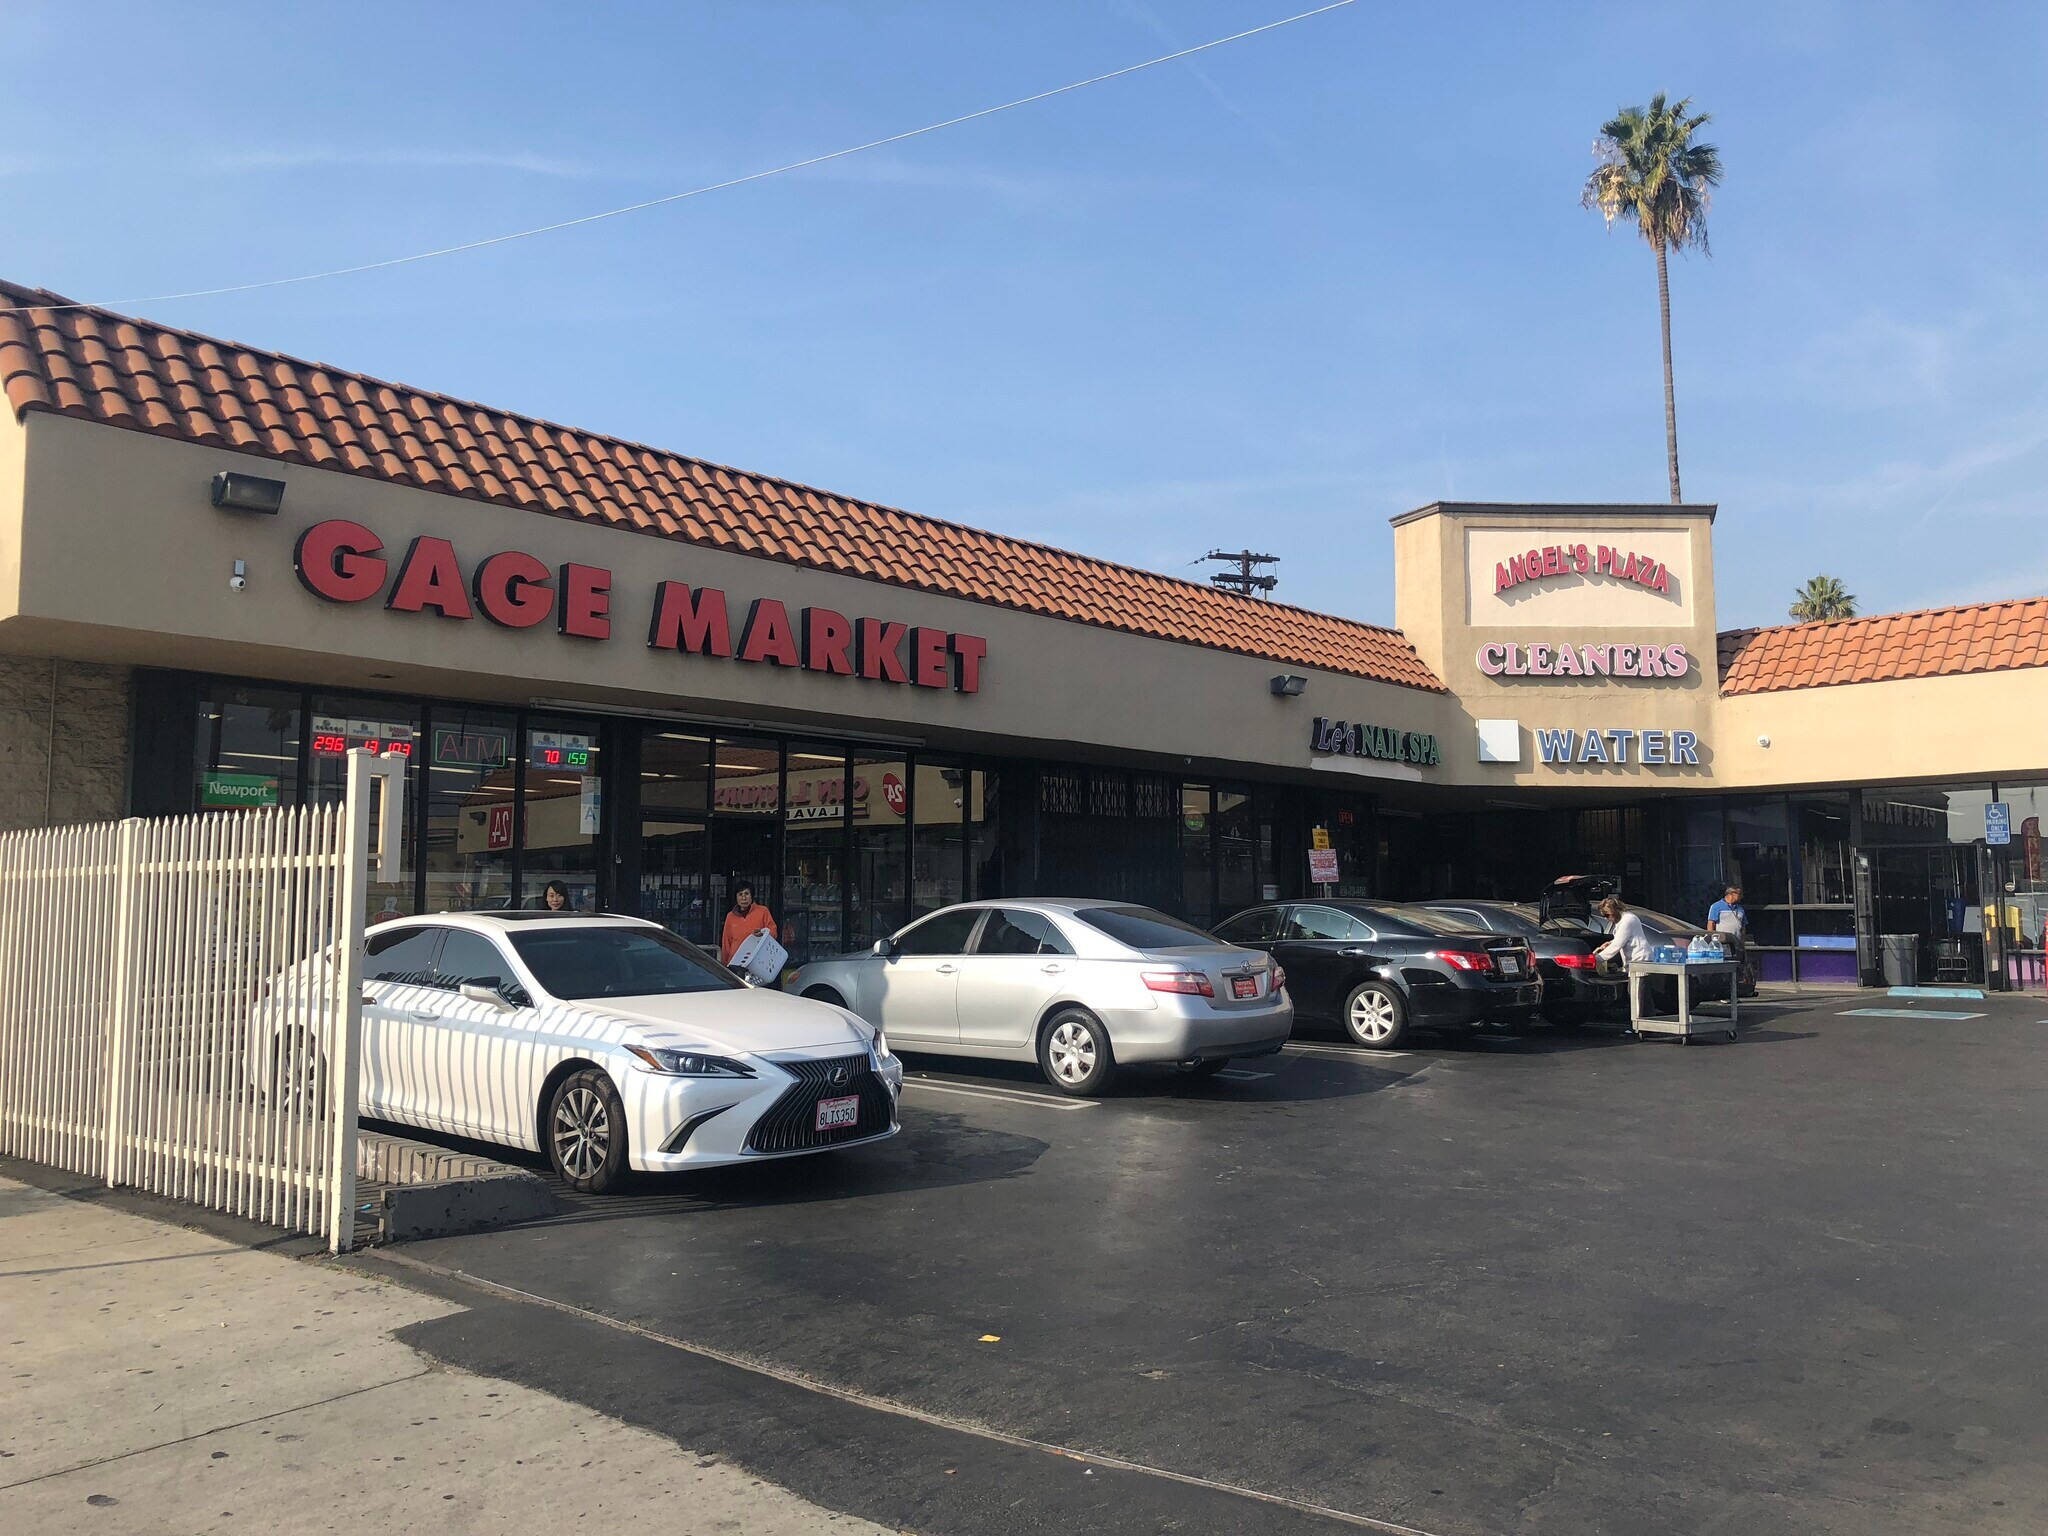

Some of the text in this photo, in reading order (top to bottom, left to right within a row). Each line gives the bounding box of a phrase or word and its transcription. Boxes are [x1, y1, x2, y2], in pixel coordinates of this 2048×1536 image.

[1494, 543, 1670, 596] ANGEL'S PLAZA
[294, 519, 988, 694] GAGE MARKET
[1475, 641, 1689, 678] CLEANERS
[313, 735, 345, 752] 296
[364, 740, 379, 755] 13
[438, 734, 502, 763] ATM
[1311, 716, 1442, 767] Le's NAIL SPA
[1533, 728, 1700, 766] WATER
[544, 749, 560, 764] 70
[567, 752, 588, 765] 159
[209, 781, 268, 798] Newport
[584, 806, 596, 821] A
[819, 1107, 856, 1126] 8LIS350
